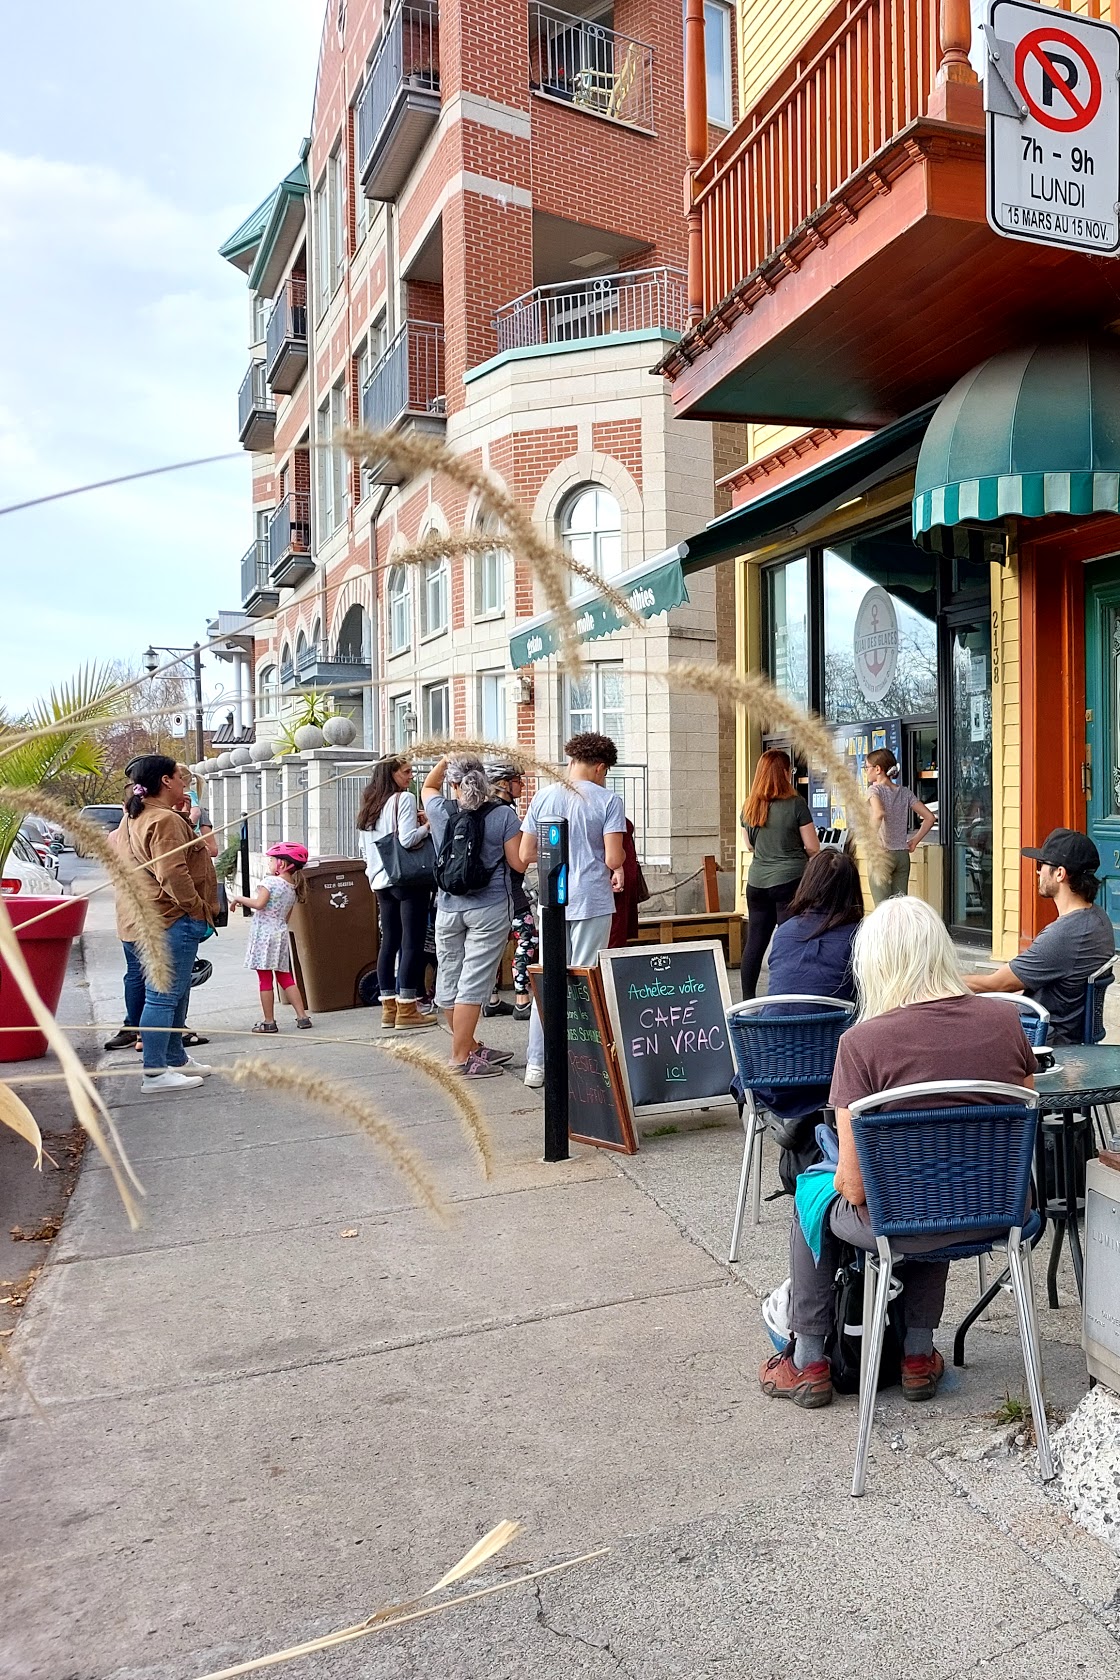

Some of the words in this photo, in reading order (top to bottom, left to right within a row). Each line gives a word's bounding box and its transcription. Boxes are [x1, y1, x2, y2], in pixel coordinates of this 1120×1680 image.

[1021, 136, 1042, 163] 7h
[1071, 148, 1094, 175] 9h
[1031, 173, 1084, 208] LUNDI
[1008, 207, 1019, 224] 15
[1023, 211, 1051, 231] MARS
[1054, 217, 1068, 233] AU
[1072, 219, 1082, 236] 15
[1086, 223, 1108, 240] NOV.
[868, 635, 877, 648] DES
[628, 977, 675, 1000] Achetez
[678, 974, 706, 995] votre
[640, 999, 698, 1029] CAFÉ
[631, 1033, 658, 1057] EN
[670, 1025, 725, 1055] VRAC
